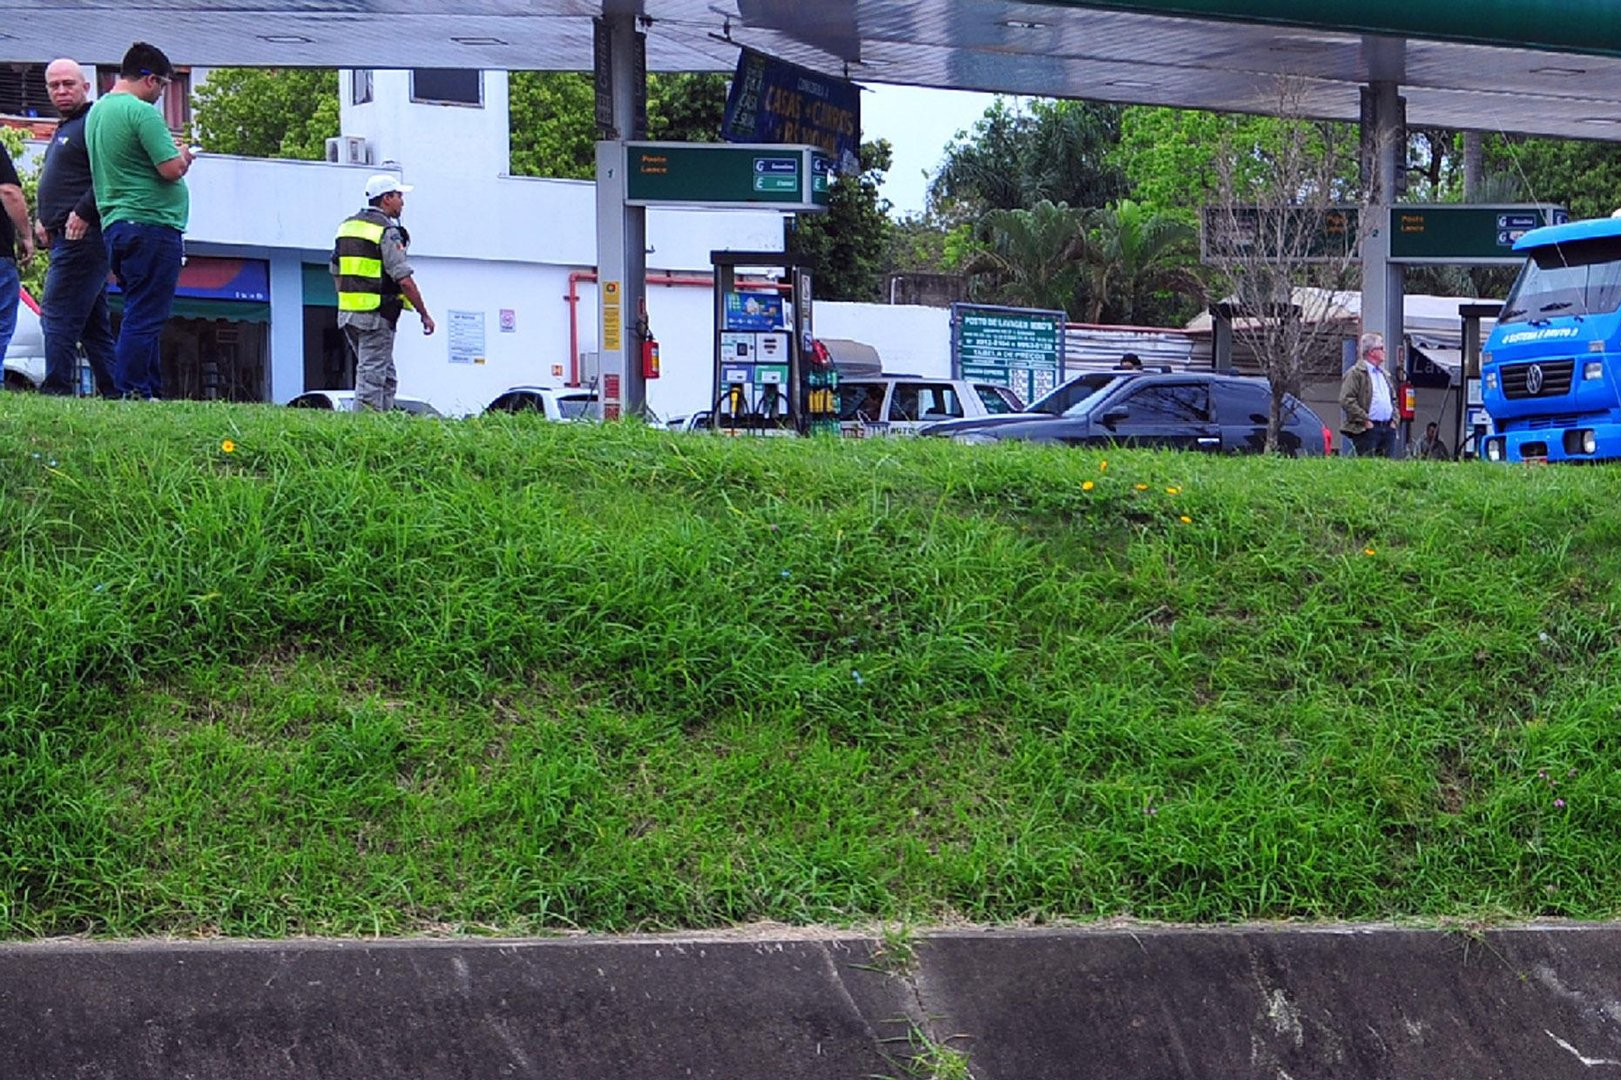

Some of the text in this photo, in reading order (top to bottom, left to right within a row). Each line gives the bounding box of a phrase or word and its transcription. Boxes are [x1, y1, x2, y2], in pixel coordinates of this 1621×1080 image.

[765, 85, 801, 119] CASAS
[755, 160, 765, 172] G
[755, 176, 765, 189] E
[1498, 216, 1507, 227] G
[1371, 229, 1379, 238] 2
[1498, 231, 1507, 243] G
[965, 316, 987, 326] POSTO
[988, 318, 997, 326] DE
[999, 318, 1028, 329] LAVAGEM
[973, 349, 1002, 357] TABELA
[1015, 352, 1046, 361] PREÇOS
